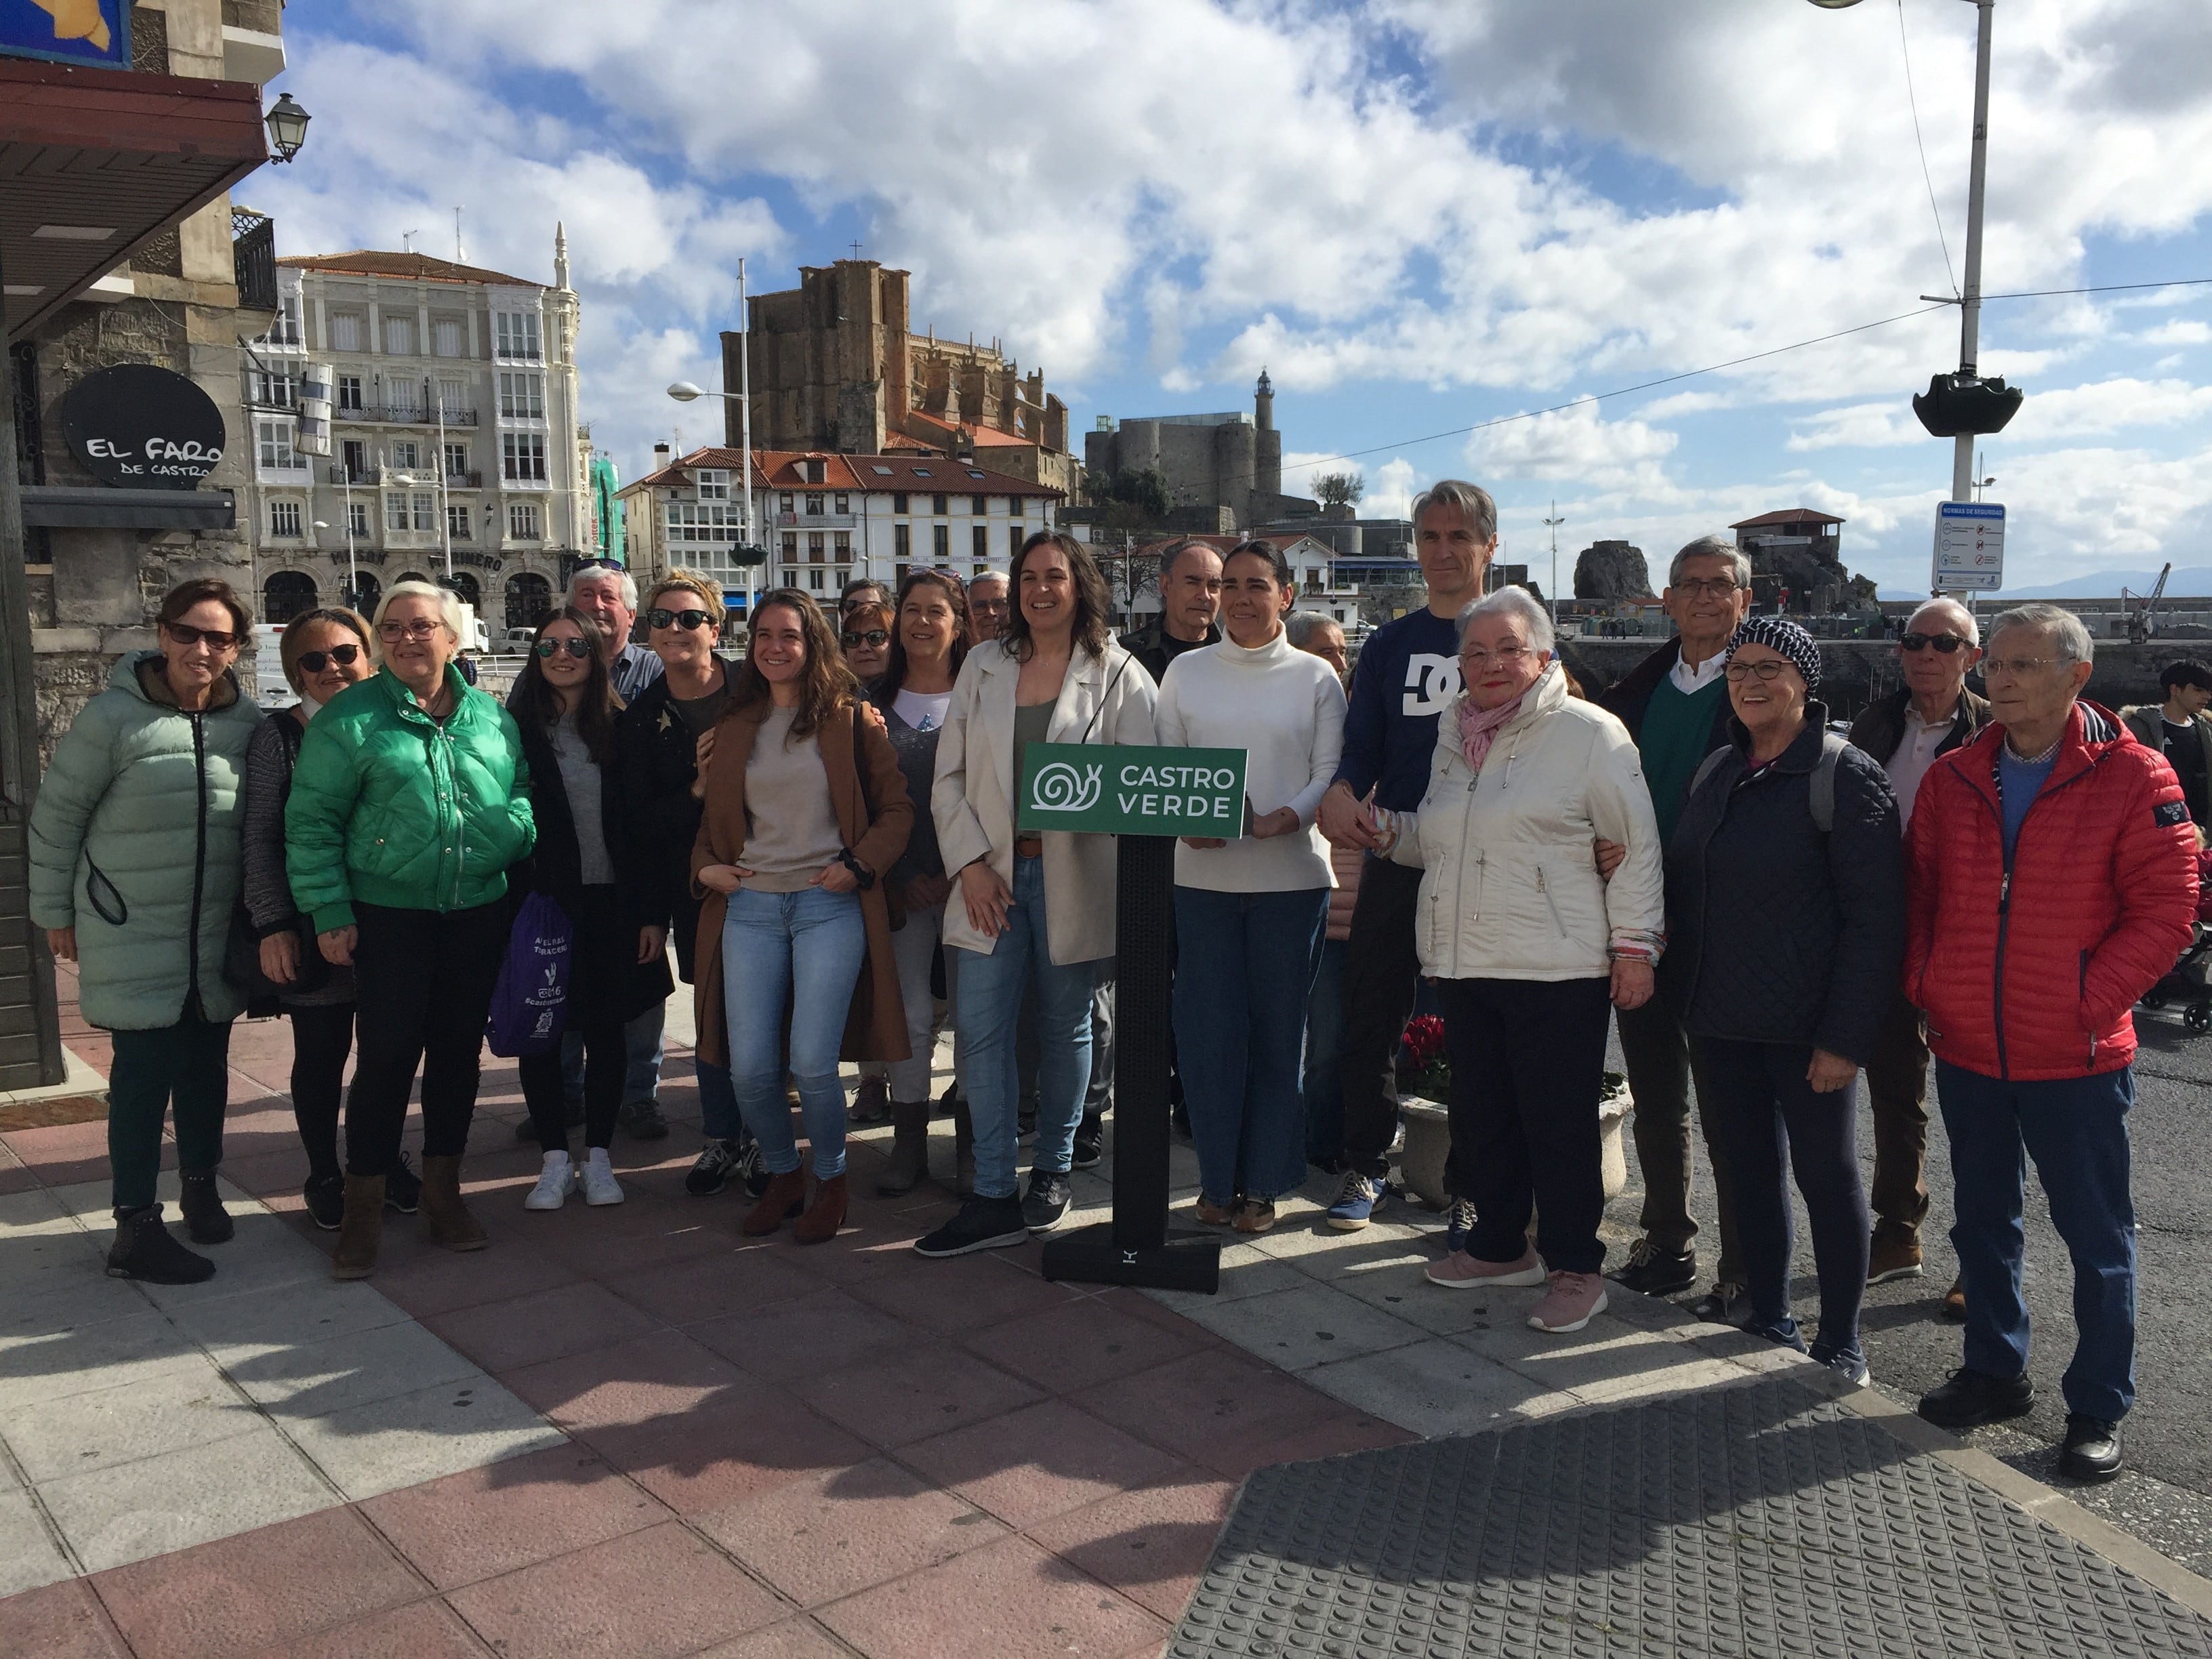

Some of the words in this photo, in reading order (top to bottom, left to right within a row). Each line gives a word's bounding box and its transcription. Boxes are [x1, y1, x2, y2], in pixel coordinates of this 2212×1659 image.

[87, 438, 131, 458] EL
[145, 438, 222, 462] FARO
[121, 463, 144, 475] DE
[151, 465, 210, 476] CASTRO
[1402, 653, 1461, 716] DC
[1120, 764, 1235, 790] CASTRO
[1118, 793, 1231, 818] VERDE
